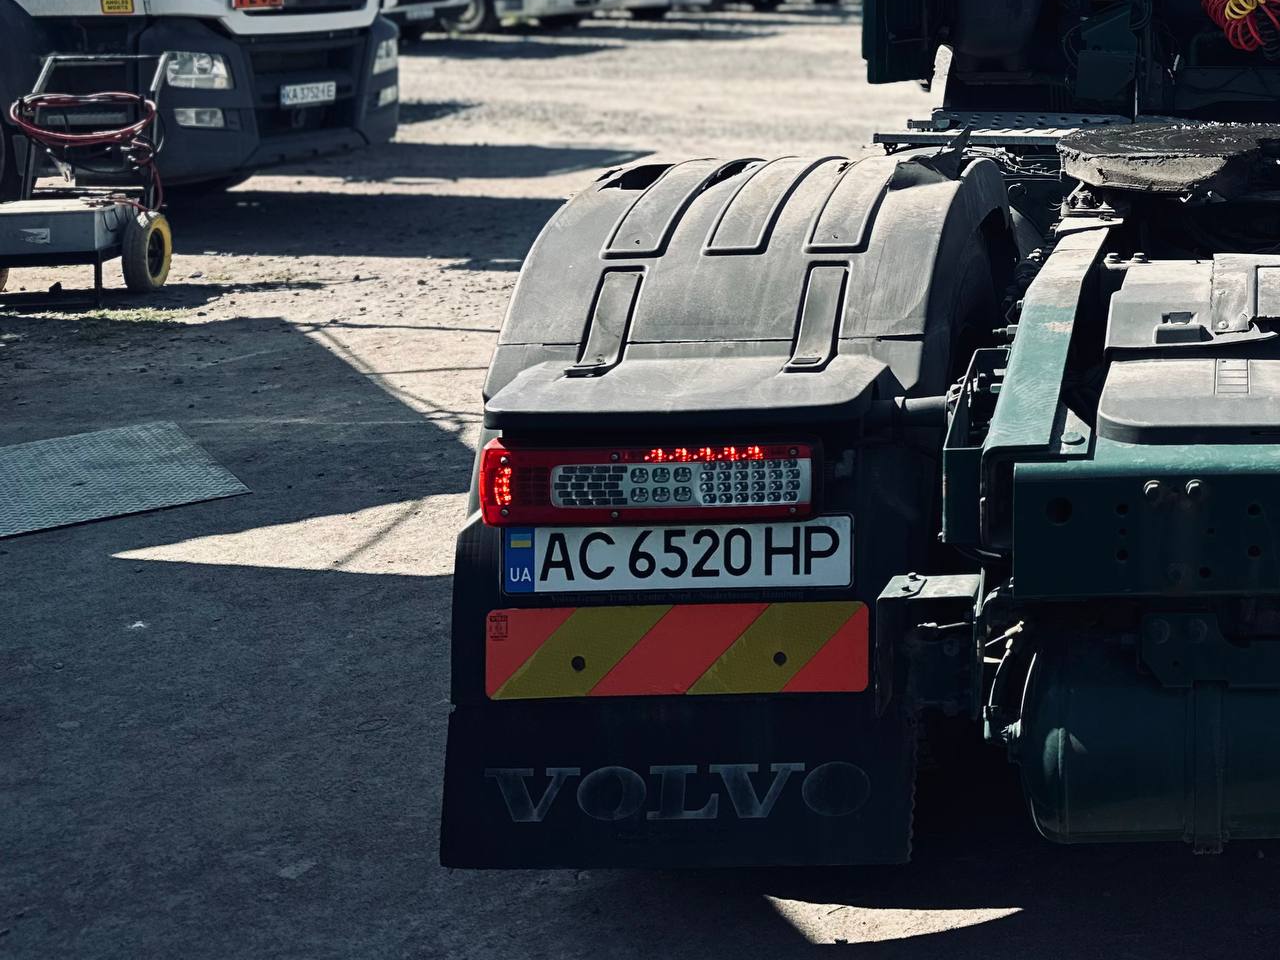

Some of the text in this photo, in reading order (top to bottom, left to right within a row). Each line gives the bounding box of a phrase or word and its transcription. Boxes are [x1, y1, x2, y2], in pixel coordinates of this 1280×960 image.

[510, 567, 532, 583] UA
[539, 525, 841, 582] AC 6520 HP
[484, 761, 872, 823] VOLVO
